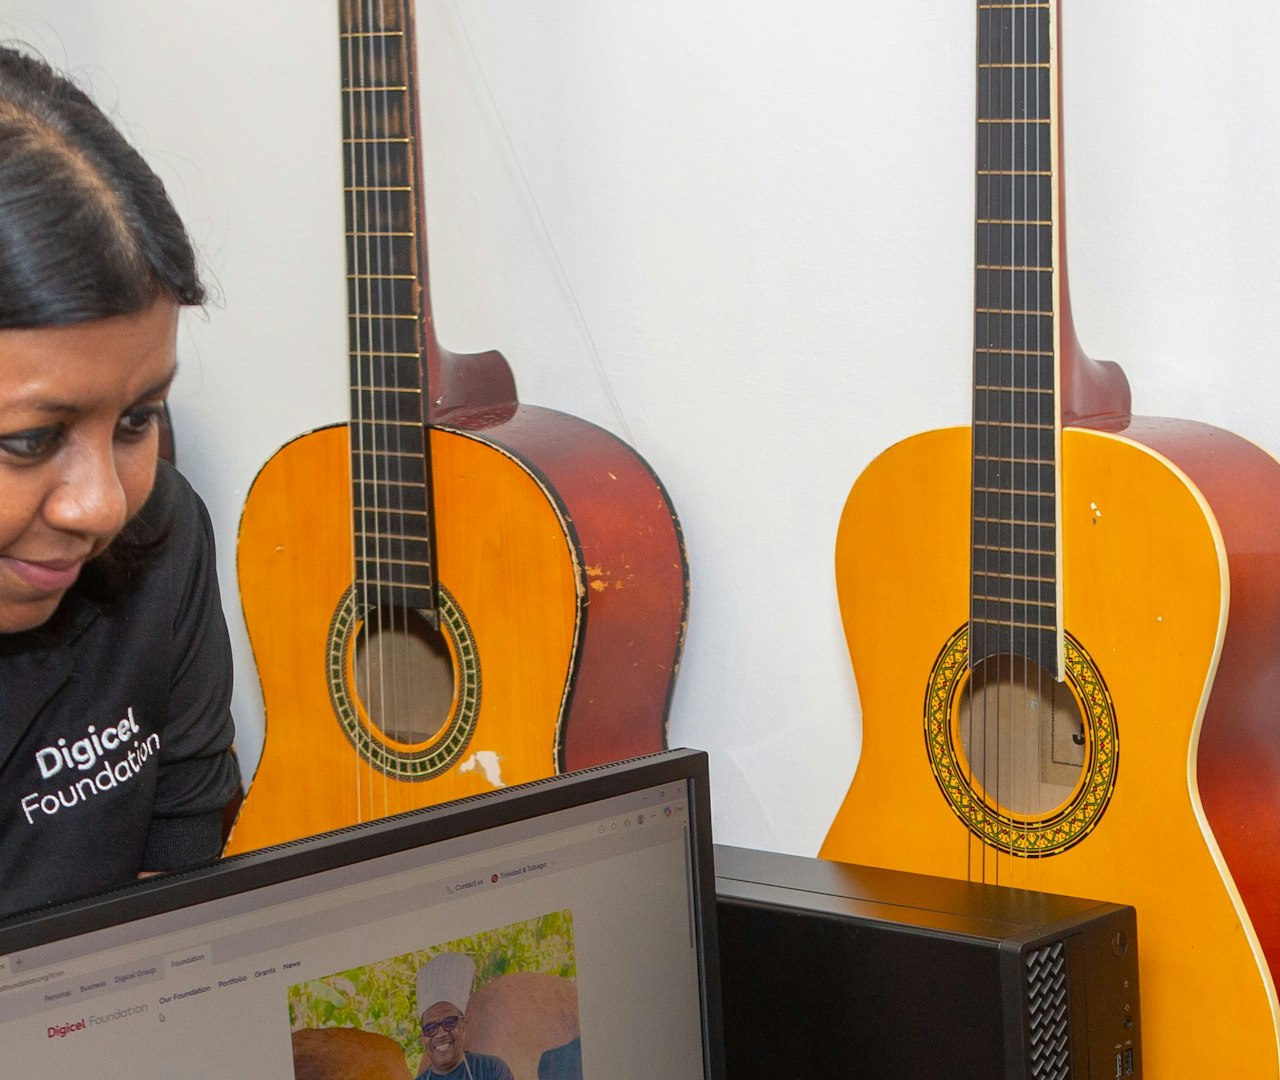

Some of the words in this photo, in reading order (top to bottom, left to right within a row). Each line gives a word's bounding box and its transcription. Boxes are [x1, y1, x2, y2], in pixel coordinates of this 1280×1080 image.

[35, 707, 140, 779] Digicel
[21, 733, 160, 824] Foundation
[455, 880, 476, 891] Contact
[171, 954, 205, 967] Foundation
[283, 960, 301, 970] News
[254, 967, 276, 978] Grants
[218, 976, 248, 988] Portfolio
[159, 996, 172, 1005] Our
[173, 986, 211, 1001] Foundation
[47, 1019, 86, 1038] Digicel
[89, 1004, 148, 1026] Foundation
